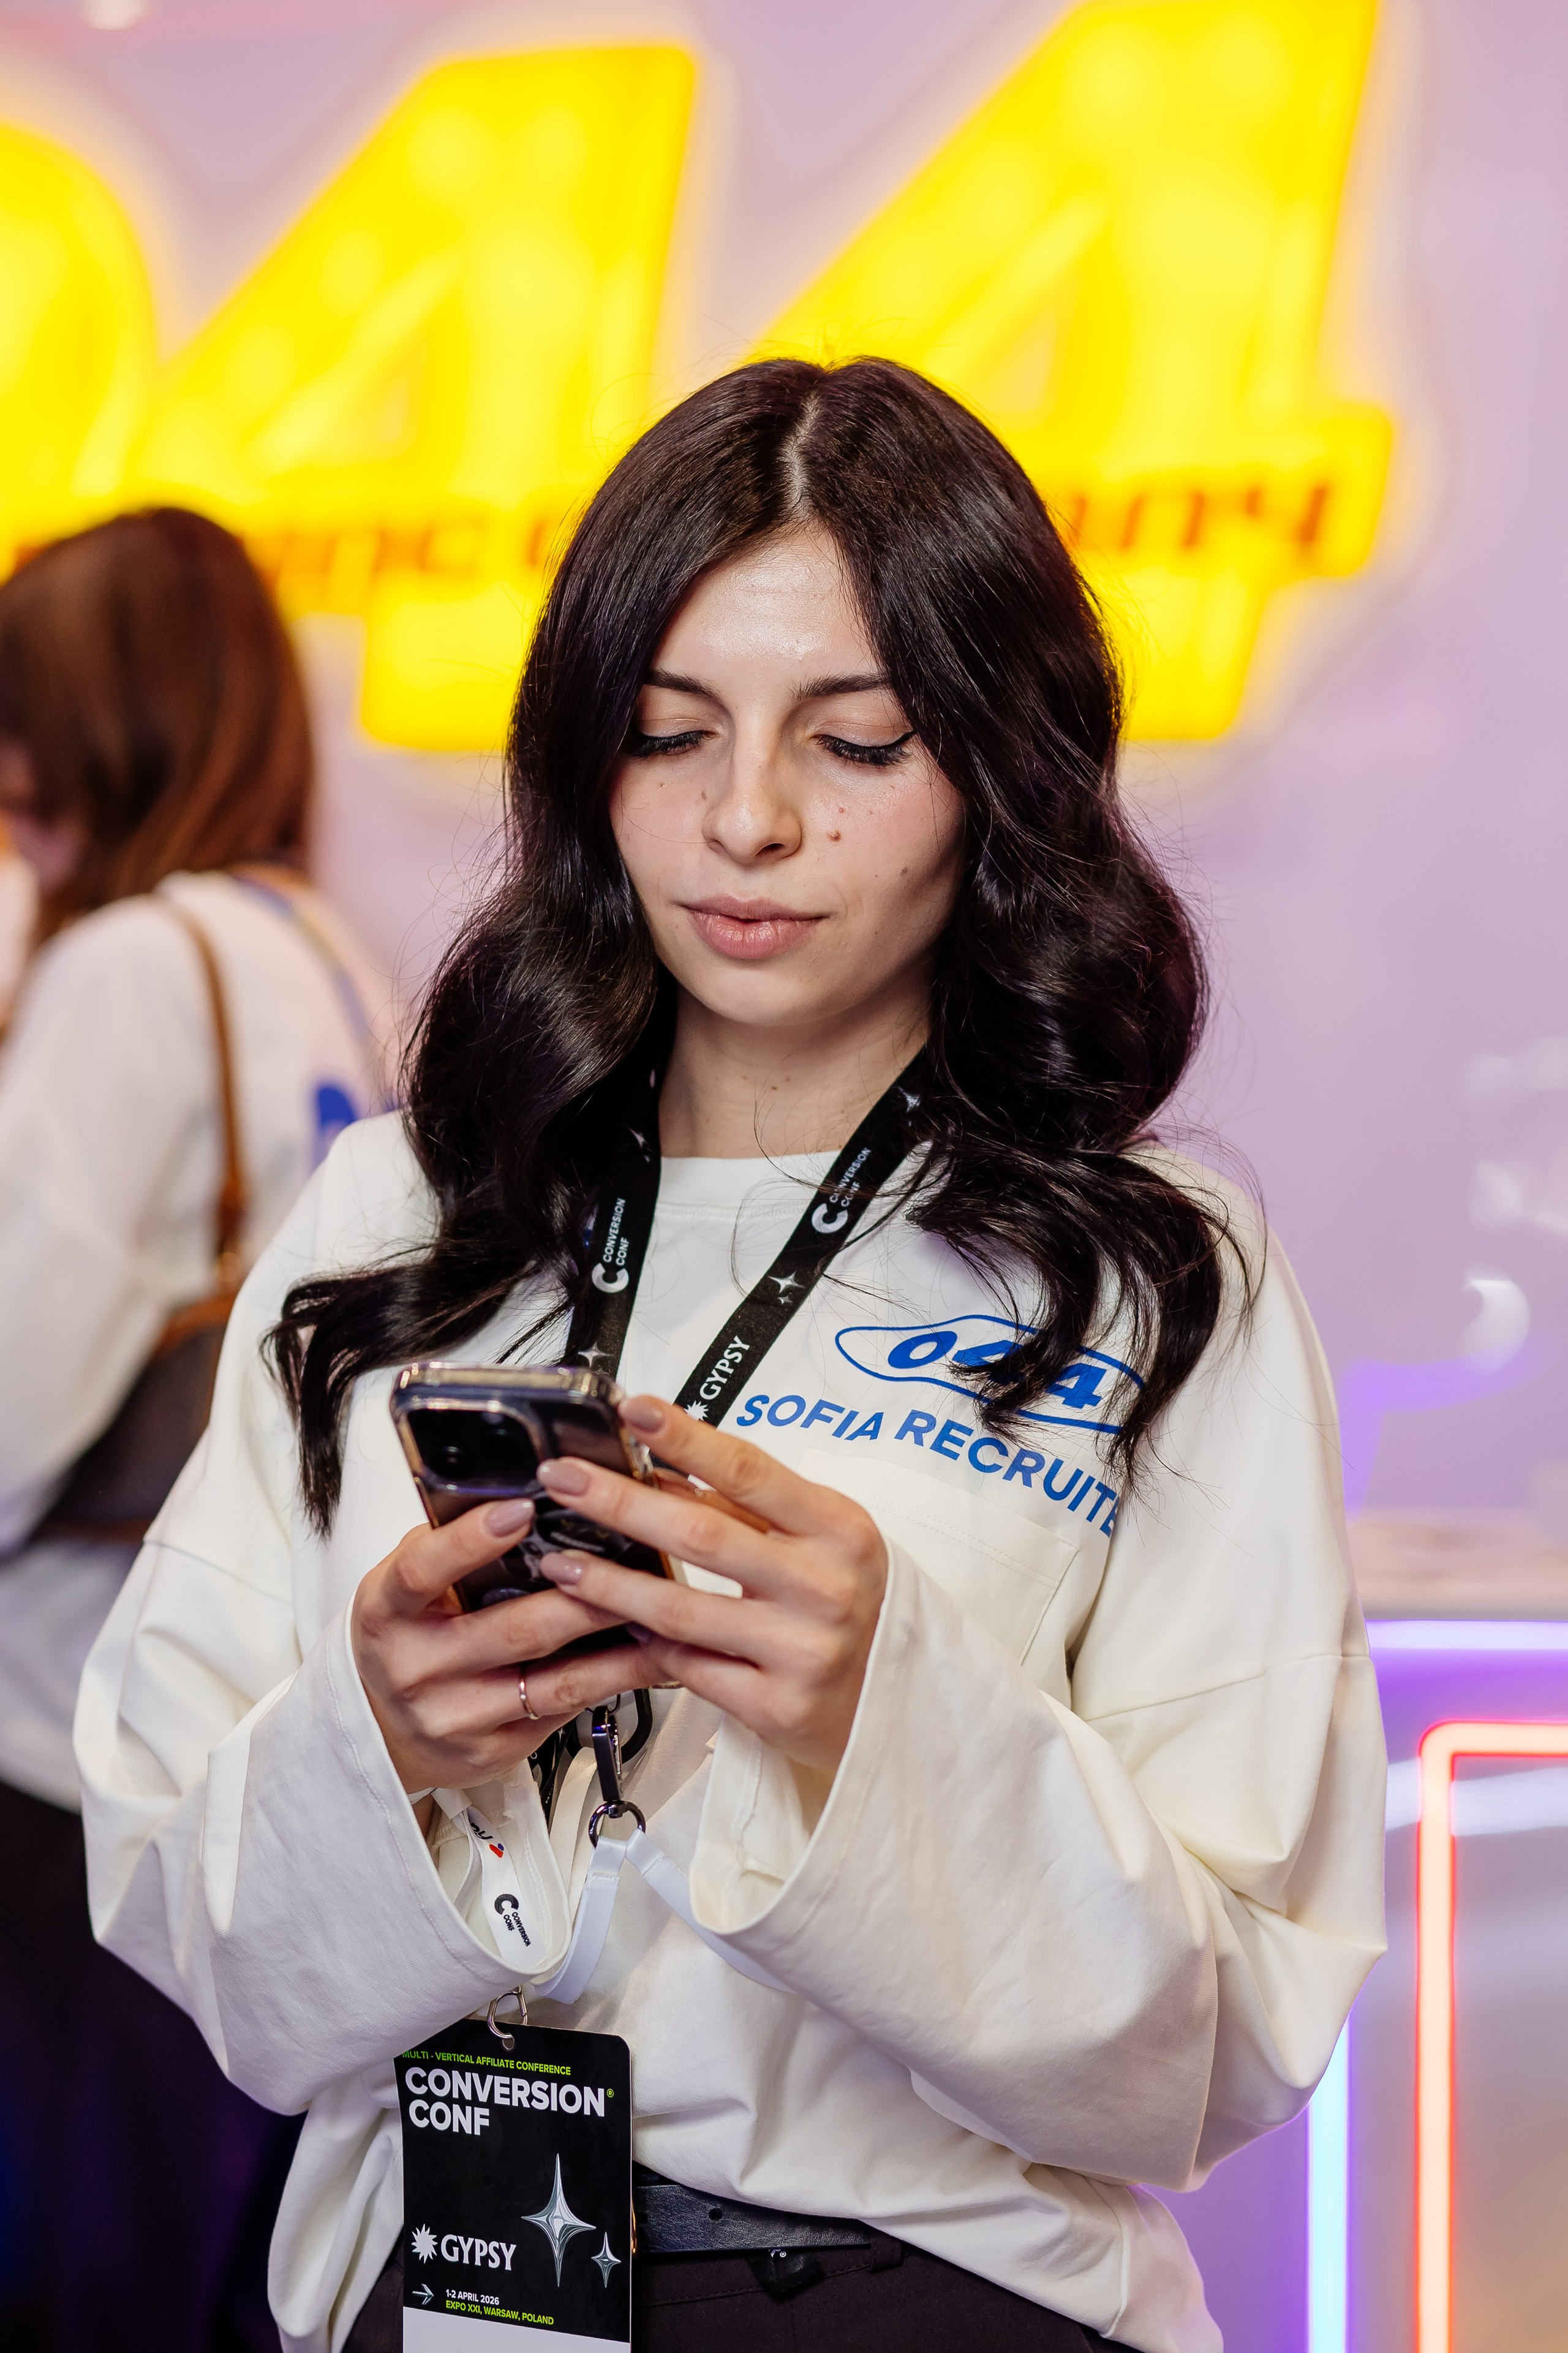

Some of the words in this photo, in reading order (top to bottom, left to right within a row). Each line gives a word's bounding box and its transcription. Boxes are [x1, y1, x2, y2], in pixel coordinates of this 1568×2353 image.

[603, 1198, 626, 1263] CONVERSION
[616, 1237, 630, 1266] CONF
[699, 1335, 750, 1400] GYPSY
[736, 1394, 884, 1441] SOFIA
[503, 1914, 514, 1932] CONF
[511, 1911, 531, 1947] CONVERSION
[402, 2050, 429, 2059] MULTI
[435, 2052, 475, 2064] VERTICAL
[476, 2058, 514, 2069] AFFILIATE
[516, 2061, 571, 2075] CONFERENCE
[409, 2099, 489, 2136] CONF
[440, 2234, 516, 2270] GYPSY
[446, 2289, 456, 2298] 1-2
[458, 2291, 478, 2302] APRIL
[480, 2294, 499, 2305] 2026
[446, 2300, 466, 2311] EXPO
[467, 2304, 482, 2315] XXI,
[484, 2306, 521, 2321] WARSAW,
[522, 2313, 554, 2325] POLAND
